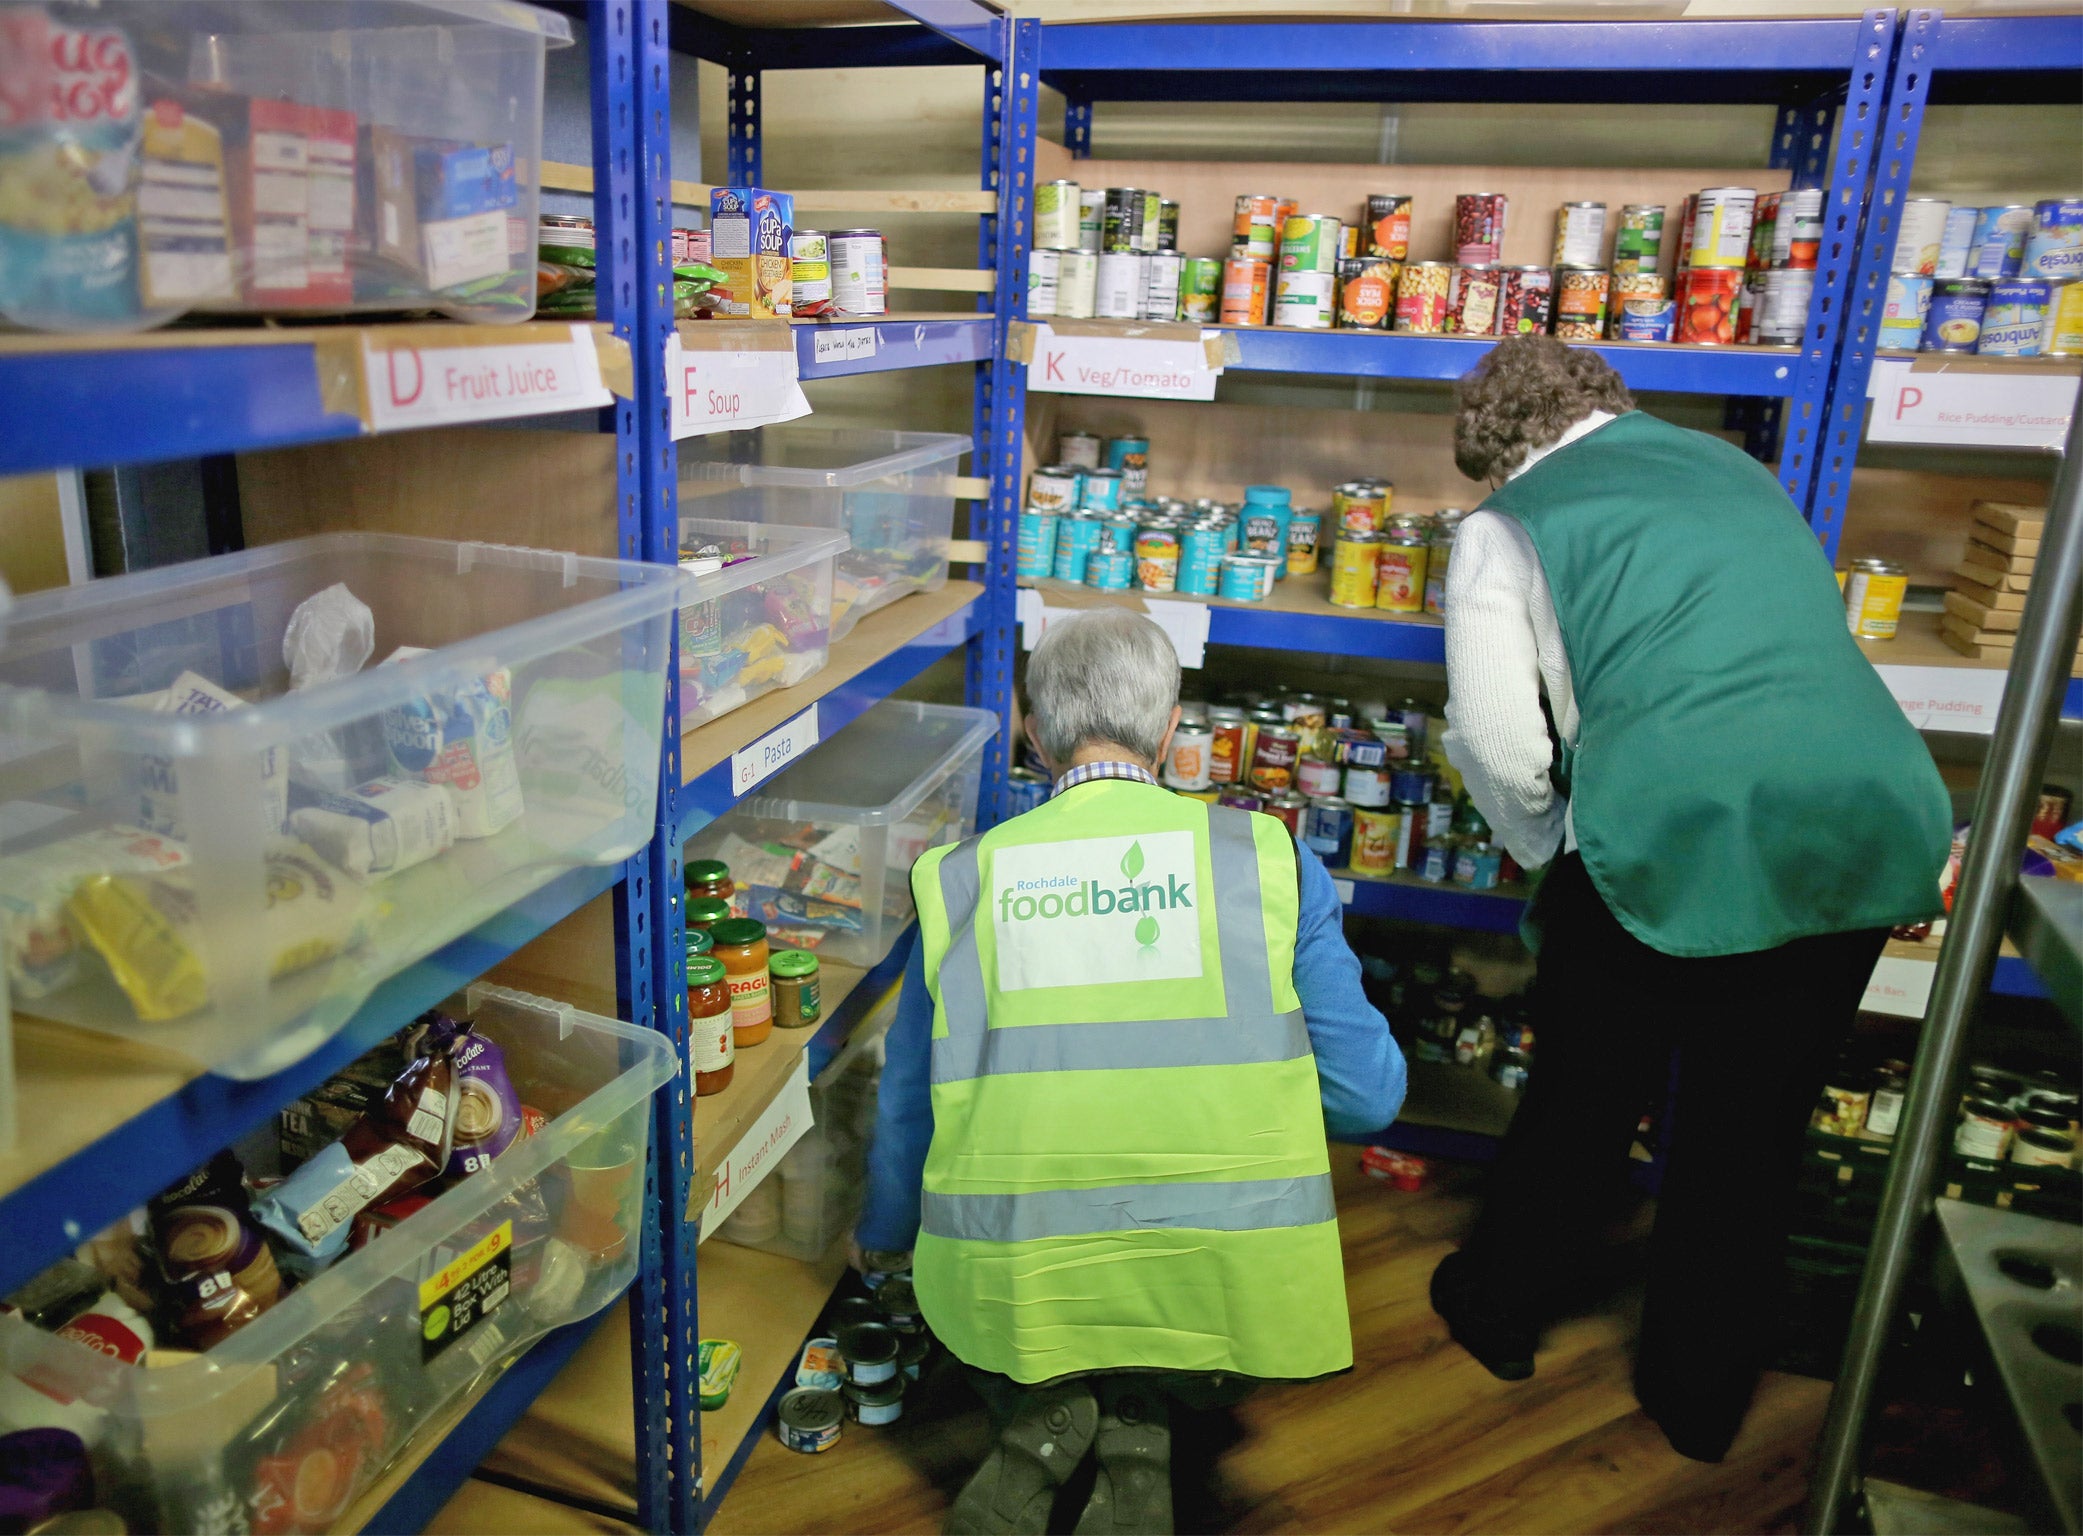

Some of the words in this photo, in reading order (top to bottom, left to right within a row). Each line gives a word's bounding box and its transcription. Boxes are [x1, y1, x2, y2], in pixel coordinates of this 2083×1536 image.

[760, 234, 782, 251] SOUP
[2039, 252, 2083, 267] brosia
[386, 342, 424, 407] D
[445, 366, 499, 401] Fruit
[504, 361, 558, 396] Juice
[1046, 352, 1065, 382] K
[1079, 366, 1191, 389] Veg/Tomato
[685, 367, 697, 417] F
[708, 390, 740, 418] Soup
[1896, 387, 1923, 421] P
[1937, 412, 1962, 423] Rice
[1965, 412, 2066, 426] Pudding/Custard
[1900, 701, 1925, 712] nge
[1928, 699, 1983, 715] Pudding
[764, 736, 792, 768] Pasta
[1017, 875, 1078, 891] Rochdale
[999, 874, 1193, 923] foodbank
[457, 1043, 485, 1069] colate
[281, 1109, 309, 1137] TEA
[464, 1157, 479, 1173] 8
[714, 1161, 729, 1208] H
[739, 1141, 768, 1182] Instant
[770, 1114, 791, 1147] Mash
[198, 1278, 218, 1299] 8
[454, 1283, 471, 1300] 42
[472, 1265, 497, 1290] Litre
[454, 1294, 478, 1318] Box
[480, 1269, 508, 1295] With
[454, 1310, 471, 1332] Lid
